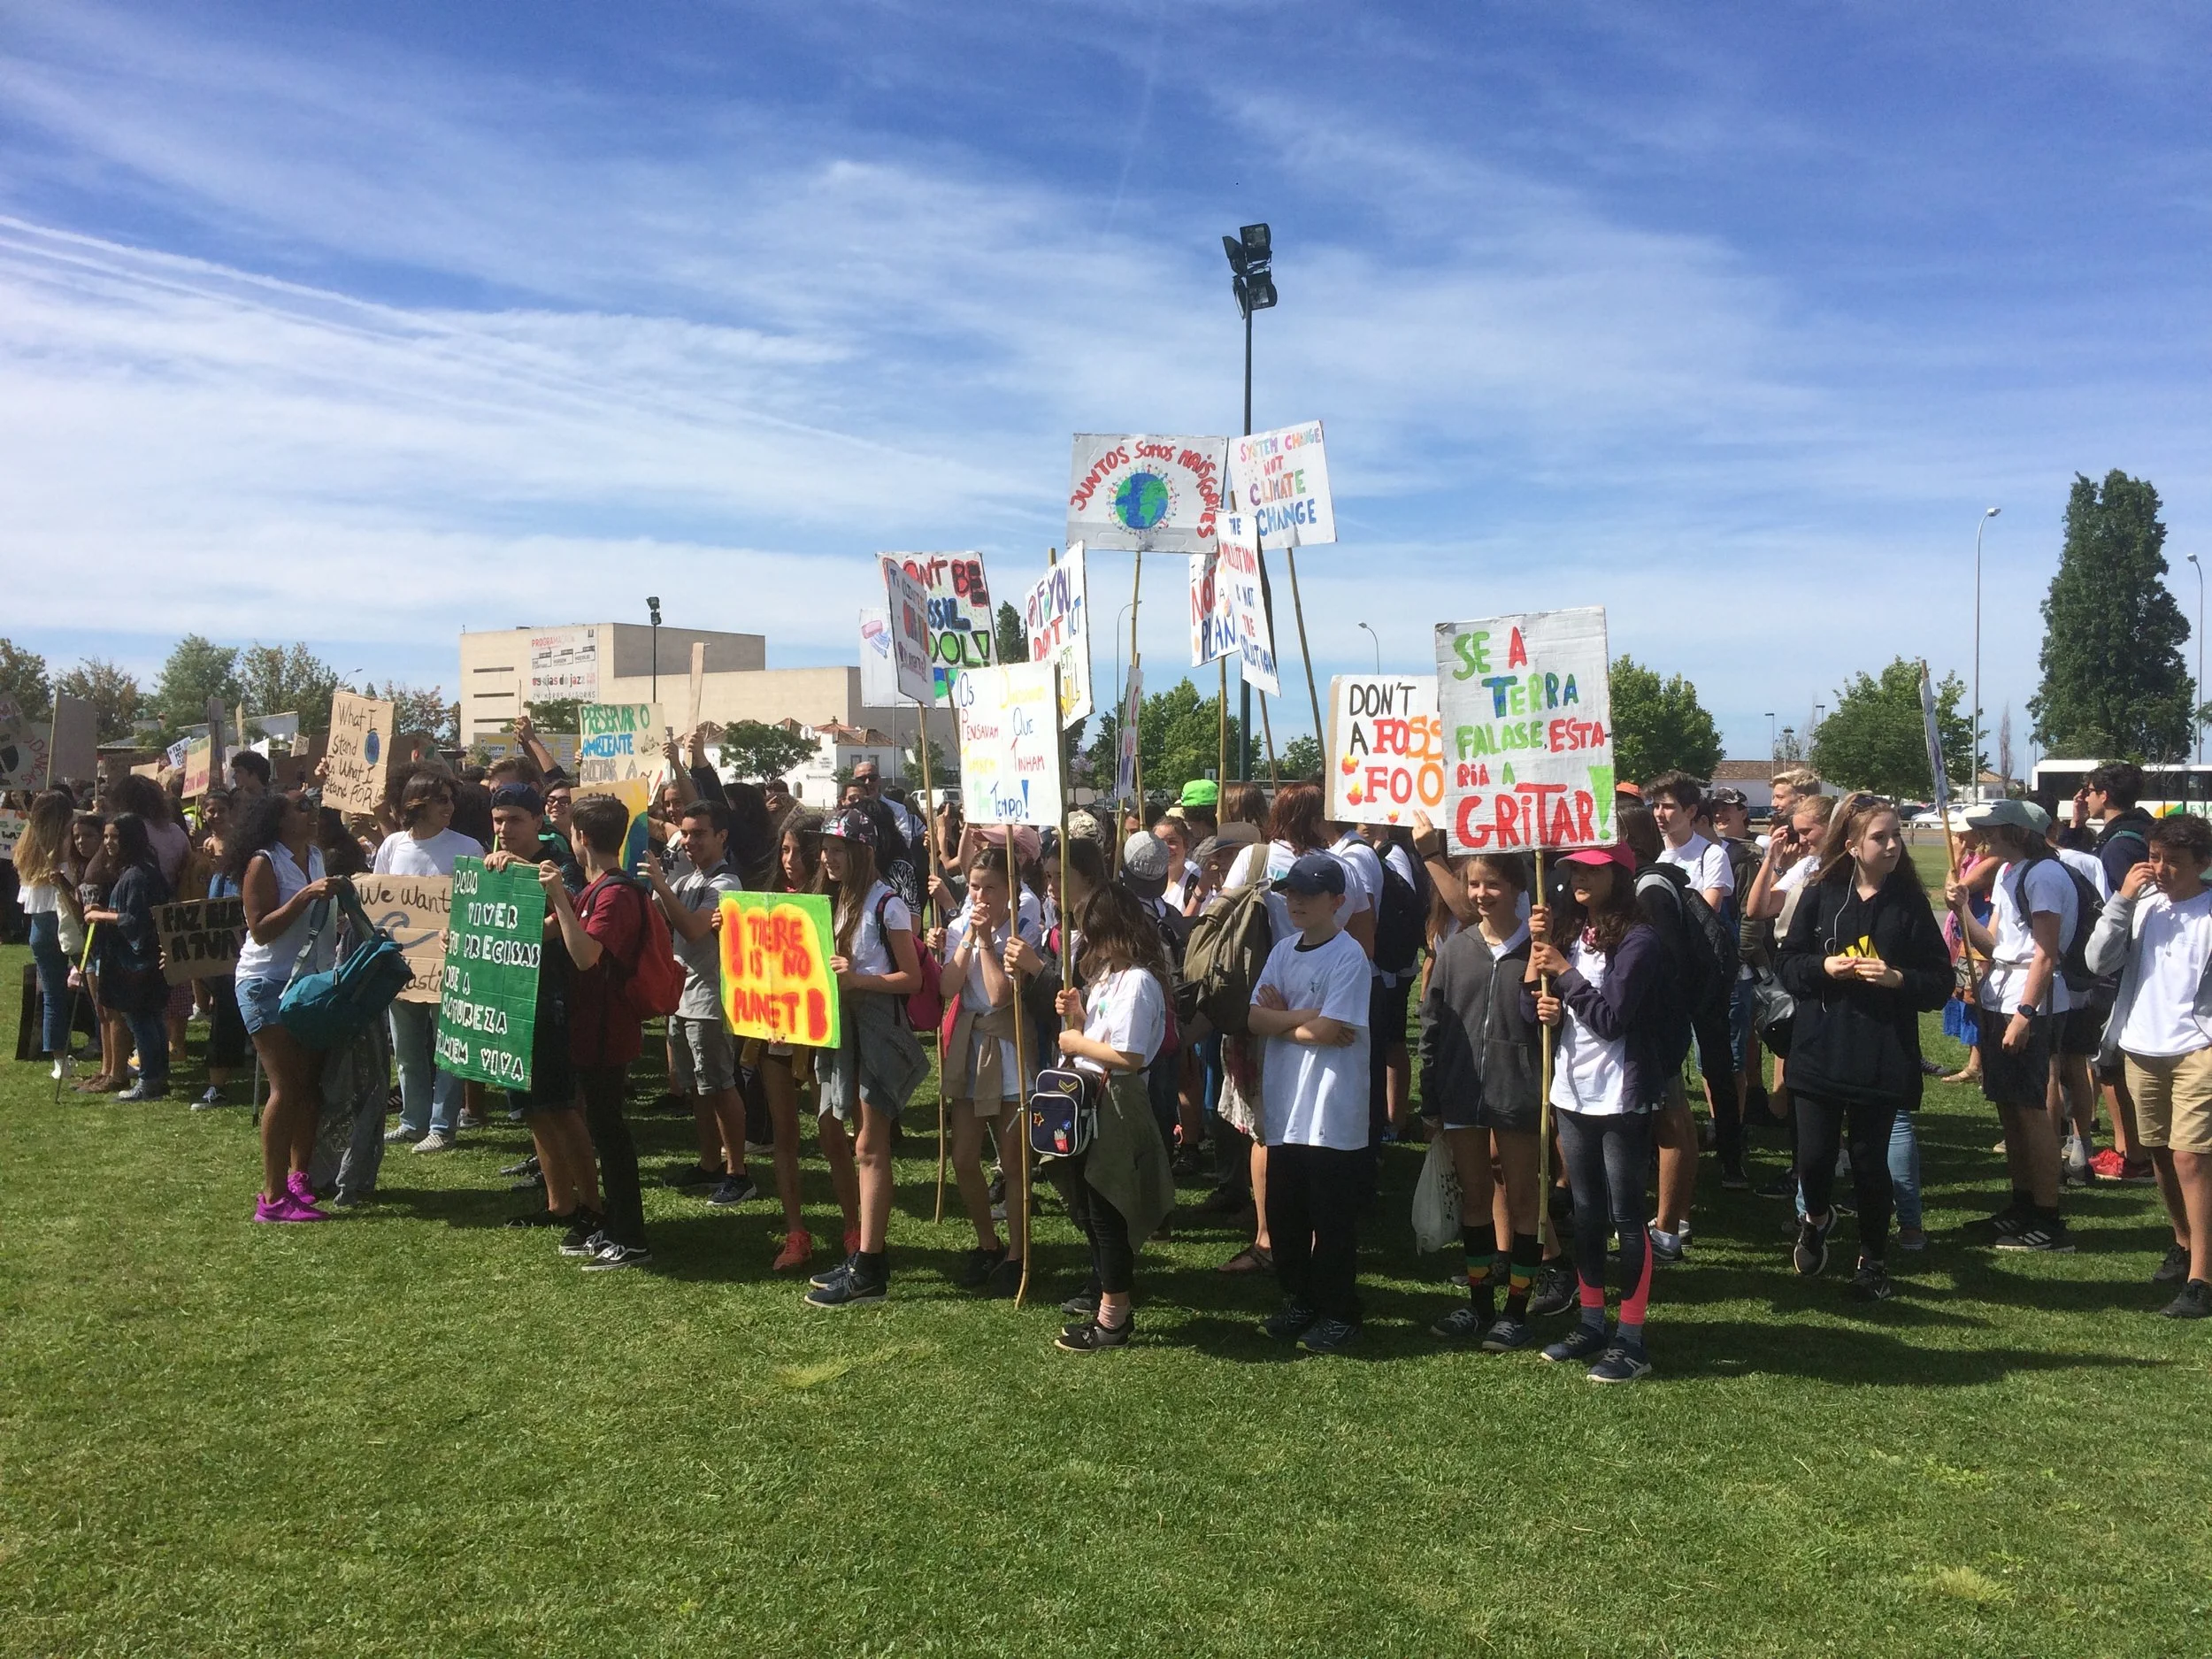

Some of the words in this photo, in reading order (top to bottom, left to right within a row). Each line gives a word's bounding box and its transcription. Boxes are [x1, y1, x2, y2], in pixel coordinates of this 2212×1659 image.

[1240, 437, 1279, 463] SYSTEM
[1285, 427, 1322, 451] CHANGE
[1070, 445, 1131, 511] JUNTOS
[1178, 449, 1216, 480] MAIS
[1263, 455, 1285, 477] NOT
[1249, 469, 1307, 506] CLIMATE
[1256, 498, 1317, 537] CHANGE
[951, 559, 988, 608] BE
[1048, 566, 1071, 619] YOU
[1191, 565, 1217, 626] NOT
[1219, 588, 1225, 602] A
[1242, 586, 1256, 609] NOT
[1240, 634, 1276, 677] SOLUTION
[1452, 631, 1492, 681] SE
[1508, 626, 1528, 670] A
[1349, 681, 1417, 718] DON'T
[1481, 672, 1579, 718] TERRA
[338, 702, 366, 732] What
[367, 709, 378, 733] I
[580, 703, 637, 735] PRESERVAR
[640, 704, 650, 729] O
[582, 733, 634, 757] AMBIENTE
[1349, 721, 1369, 757] A
[339, 760, 364, 782] What
[362, 765, 375, 784] I
[625, 759, 638, 780] A
[1363, 762, 1445, 808] FOO
[1502, 761, 1516, 786] A
[360, 881, 395, 905] We
[468, 902, 518, 929] VIVER
[463, 933, 541, 969] PRECISAS
[747, 916, 804, 953] THERE
[749, 947, 763, 979] IS
[782, 944, 812, 981] NO
[444, 965, 458, 993] QUE
[462, 972, 471, 997] A
[442, 992, 508, 1035] NATUREZA
[733, 987, 801, 1034] PLANET
[806, 987, 828, 1041] B
[480, 1048, 524, 1083] VIVA
